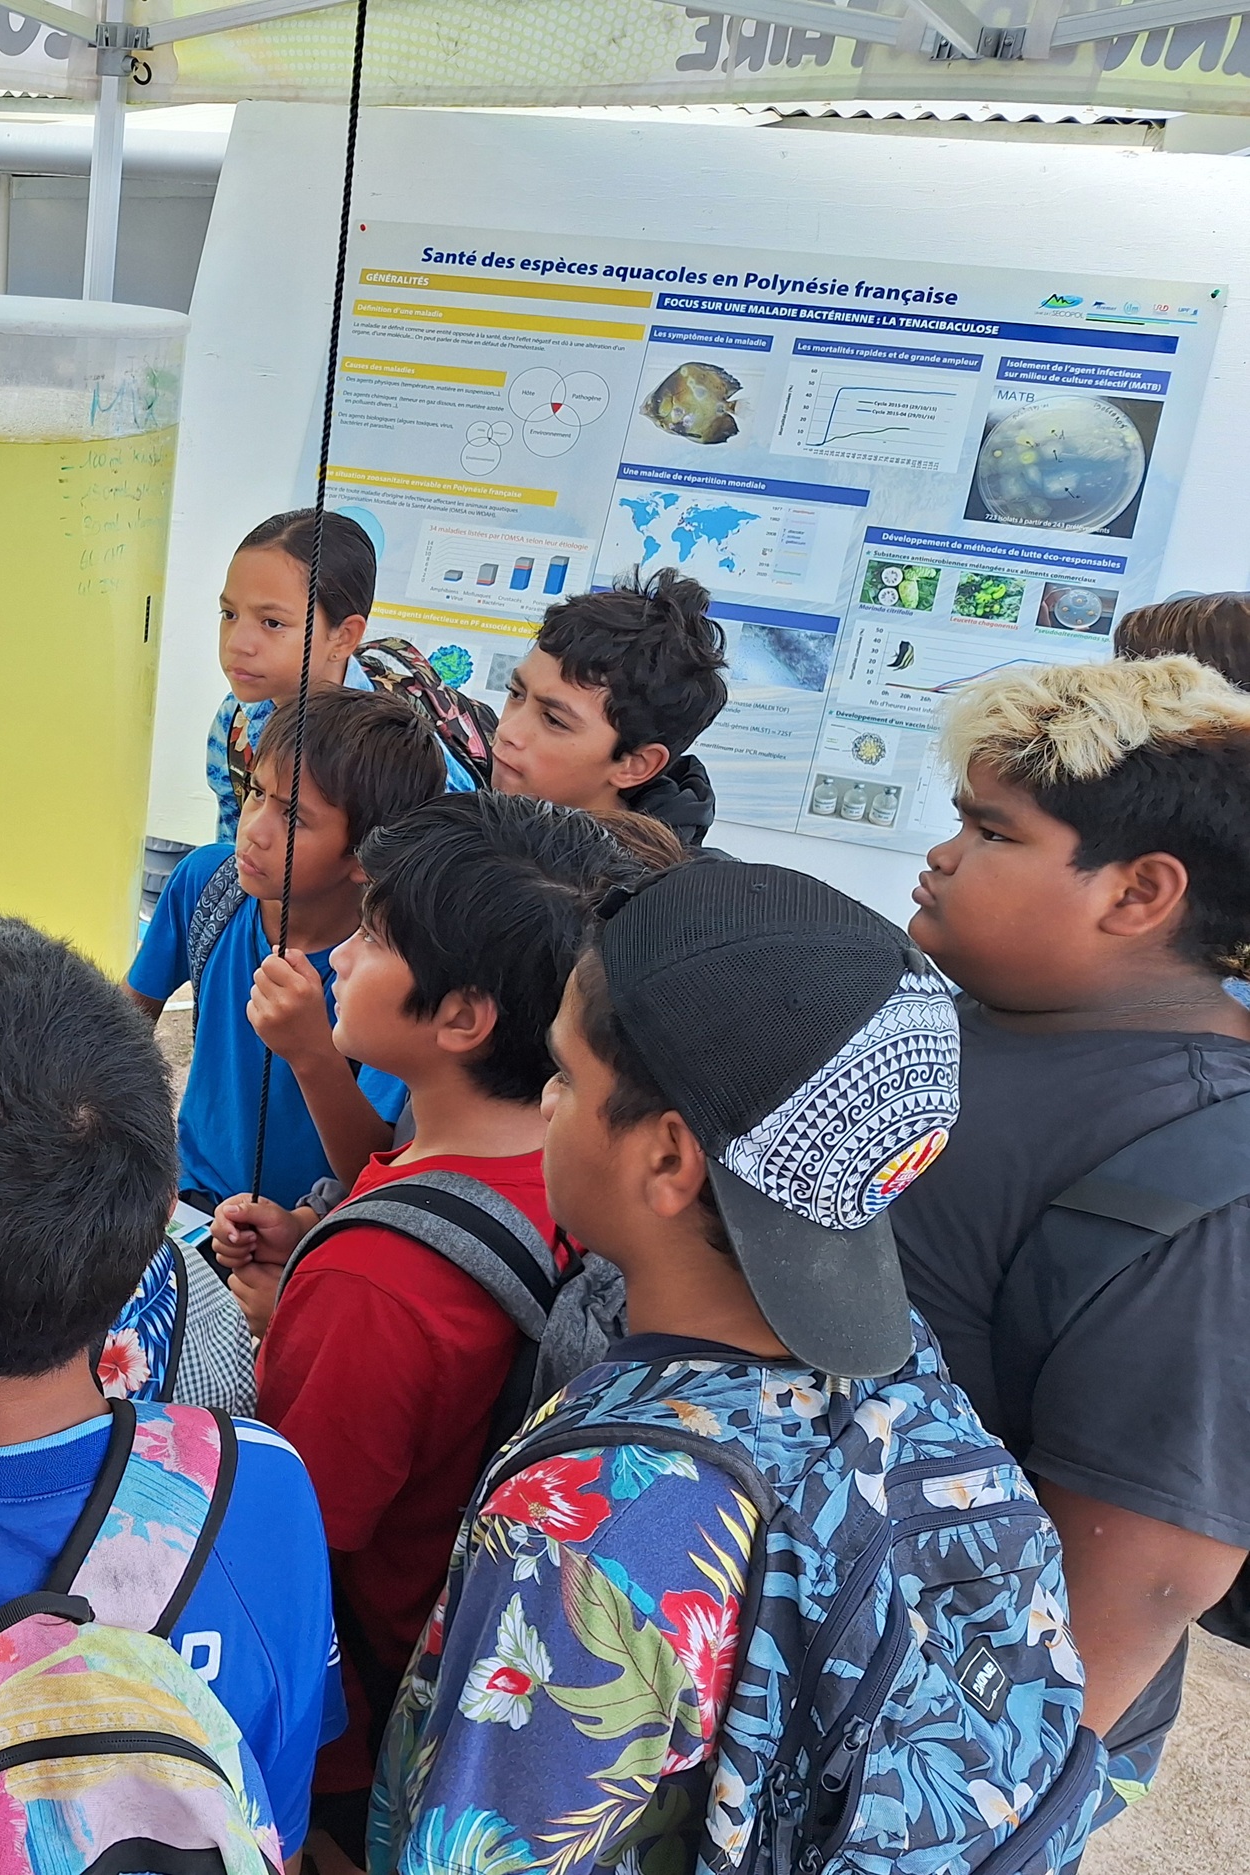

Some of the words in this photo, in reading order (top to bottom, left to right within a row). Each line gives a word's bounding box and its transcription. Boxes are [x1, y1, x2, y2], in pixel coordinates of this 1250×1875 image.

[366, 272, 430, 286] GÉNÉRALITÉS
[421, 247, 477, 265] Santé
[480, 251, 516, 268] des
[519, 257, 599, 275] espèces
[602, 264, 707, 284] aquacoles
[712, 274, 739, 286] en
[744, 273, 850, 296] Polynésie
[853, 282, 959, 305] française
[357, 303, 392, 313] Définition
[392, 306, 415, 315] d'une
[416, 309, 443, 318] maladie
[663, 296, 700, 309] FOCUS
[702, 300, 722, 311] SUR
[724, 301, 746, 313] UNE
[748, 304, 797, 318] MALADIE
[799, 308, 874, 324] BACTÉRIENNE
[882, 315, 897, 326] LA
[900, 317, 1000, 335] TENACIBACULOSE
[653, 329, 667, 338] Les
[668, 332, 711, 342] symptômes
[713, 335, 724, 343] de
[725, 336, 733, 344] la
[734, 338, 767, 347] maladie
[797, 342, 811, 350] Les
[812, 345, 855, 355] mortalités
[855, 349, 887, 358] rapides
[898, 351, 909, 360] de
[910, 354, 941, 362] grande
[942, 357, 979, 366] ampleur
[344, 361, 371, 370] Causes
[371, 363, 383, 371] des
[383, 365, 415, 374] maladies
[1006, 360, 1051, 371] Isolement
[1051, 363, 1063, 372] de
[1064, 364, 1095, 376] l'agent
[1096, 367, 1142, 379] infectieux
[1004, 371, 1020, 379] sur
[1021, 371, 1048, 381] milieu
[1048, 373, 1060, 382] de
[1062, 375, 1093, 385] culture
[1094, 377, 1128, 388] sélectif
[1128, 380, 1161, 393] (MATB)
[997, 388, 1036, 403] MATB
[335, 470, 366, 480] situation
[366, 474, 410, 485] zoosanitaire
[411, 479, 442, 488] enviable
[452, 483, 487, 493] Polynésie
[488, 487, 522, 498] française
[622, 467, 639, 476] Une
[639, 470, 671, 480] maladie
[672, 473, 683, 481] de
[683, 474, 727, 485] répartition
[727, 480, 766, 489] mondiale
[428, 524, 438, 532] 34
[438, 526, 467, 535] maladies
[468, 529, 488, 538] listées
[500, 533, 525, 542] l'OMSA
[544, 538, 558, 546] leur
[558, 540, 589, 551] étiologie
[881, 532, 949, 548] Développement
[950, 541, 962, 550] de
[963, 543, 1007, 555] méthodes
[1008, 547, 1020, 556] de
[1020, 549, 1042, 559] lutte
[1043, 552, 1121, 569] éco-responsables
[873, 551, 908, 561] Substances
[910, 556, 968, 568] antimicrobiennes
[969, 562, 1005, 573] mélangées
[1020, 568, 1049, 577] aliments
[1050, 573, 1096, 583] commerciaux
[858, 604, 886, 613] Morinda
[886, 607, 914, 616] citrifolia
[397, 610, 422, 619] agents
[422, 612, 459, 624] infectieux
[471, 619, 480, 627] PF
[480, 622, 512, 631] associés
[518, 625, 532, 634] des
[835, 710, 888, 723] Développement
[888, 717, 904, 725] d'un
